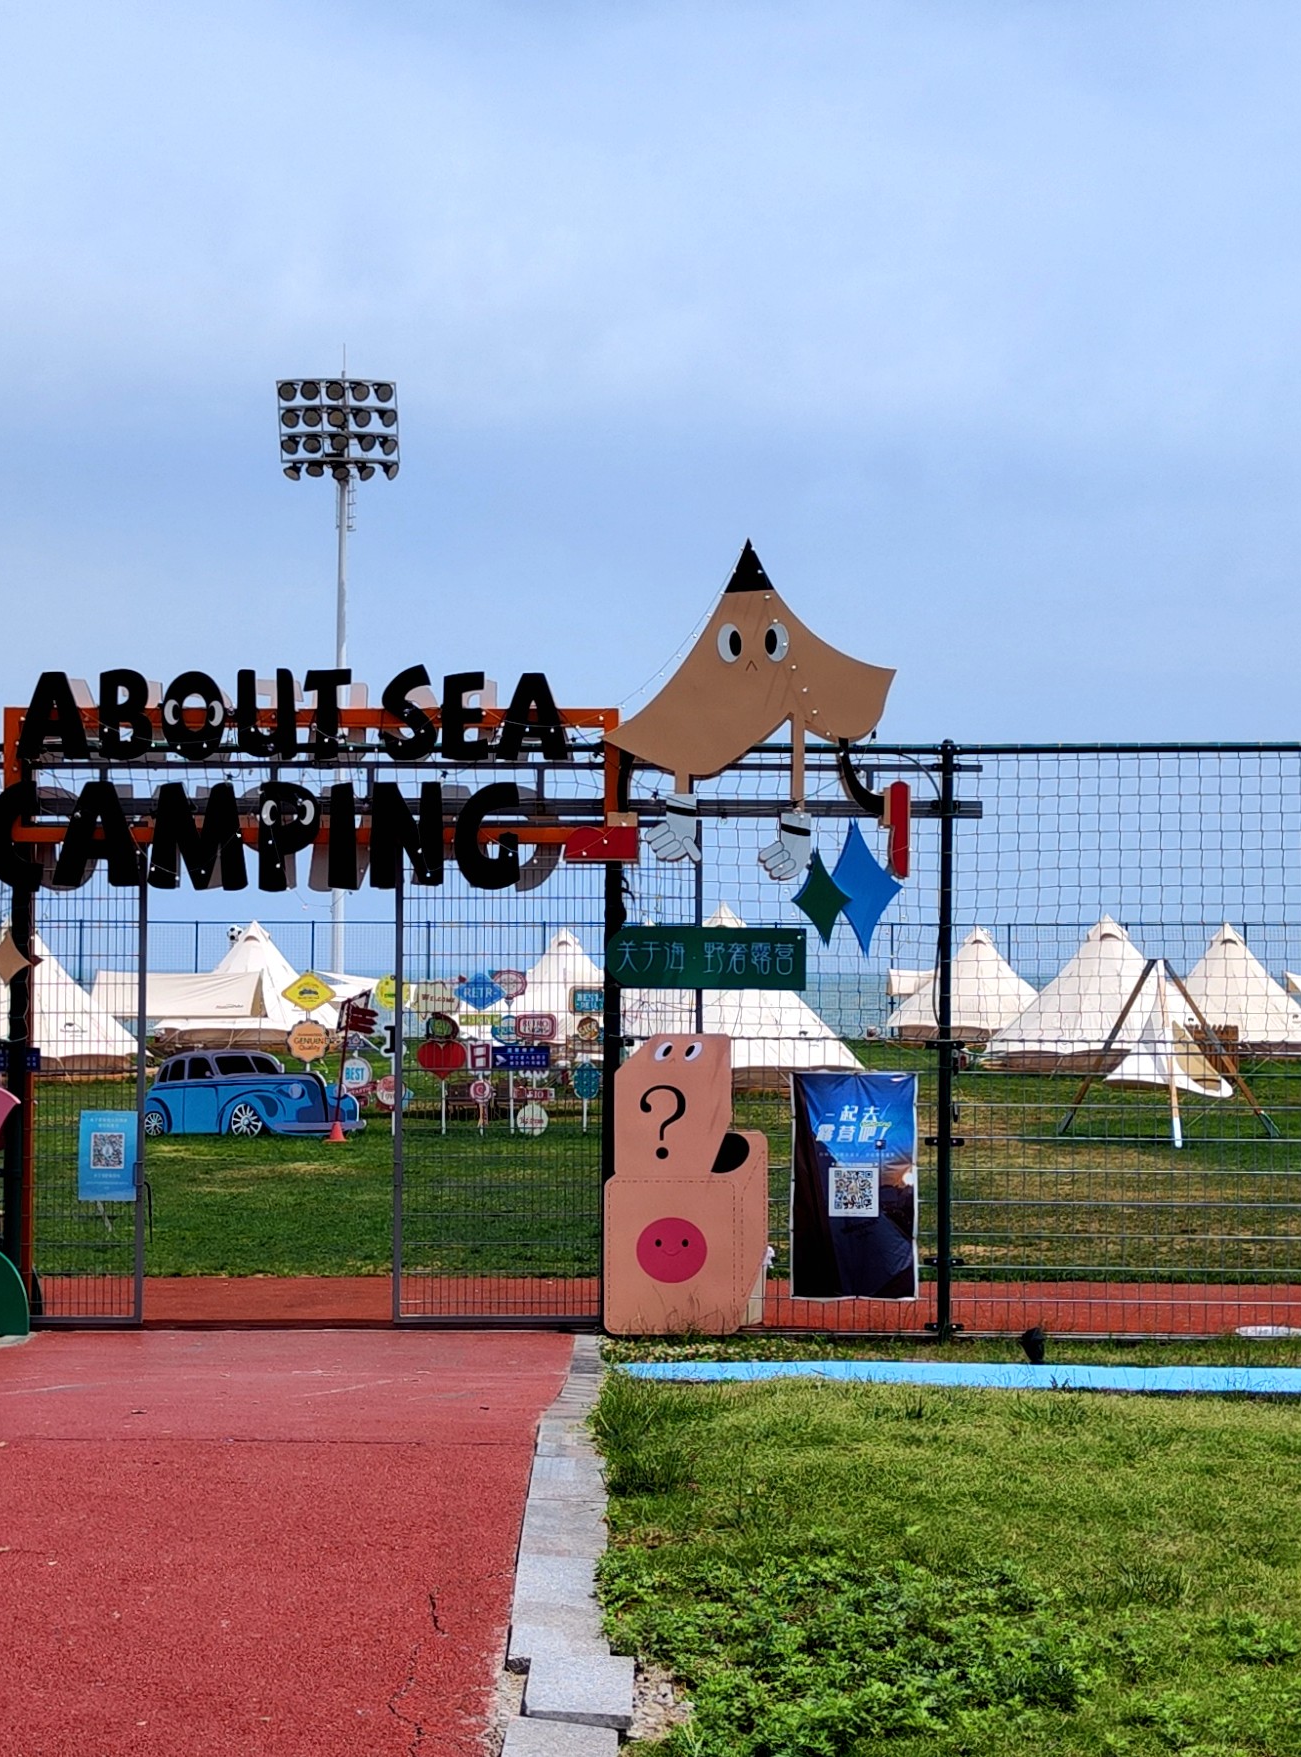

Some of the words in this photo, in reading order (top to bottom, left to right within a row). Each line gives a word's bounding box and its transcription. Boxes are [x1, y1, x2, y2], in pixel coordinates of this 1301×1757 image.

[16, 668, 352, 760] ABOUT
[381, 664, 568, 760] SEA
[345, 1068, 365, 1080] BEST
[825, 1105, 880, 1122] 一起去
